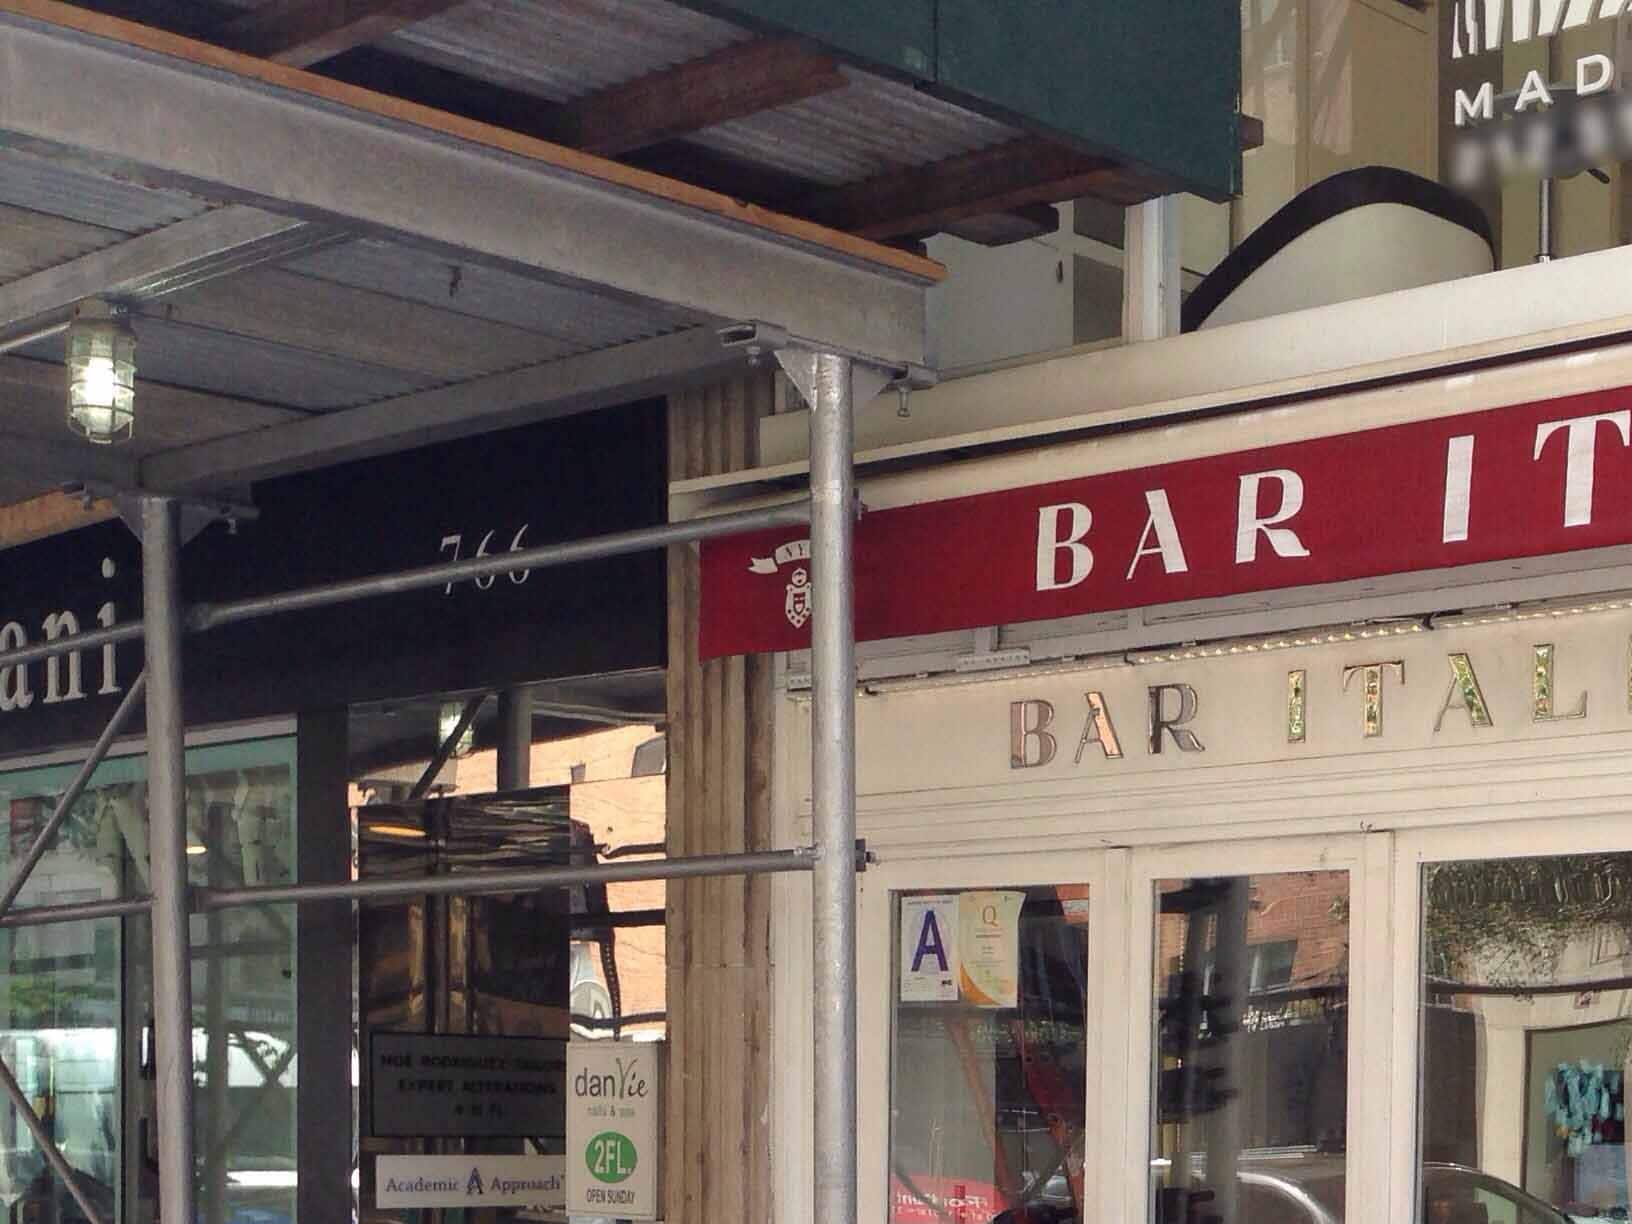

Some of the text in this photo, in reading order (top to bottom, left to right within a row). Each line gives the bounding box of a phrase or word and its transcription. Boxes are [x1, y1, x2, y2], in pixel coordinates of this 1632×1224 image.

[440, 523, 529, 595] 766
[1036, 468, 1310, 591] BAR
[1009, 682, 1205, 769] BAR
[911, 910, 949, 972] A
[983, 905, 999, 927] Q
[386, 1177, 458, 1192] Academic
[490, 1175, 561, 1194] Approach
[587, 1189, 635, 1205] OPEN SUNDAY
